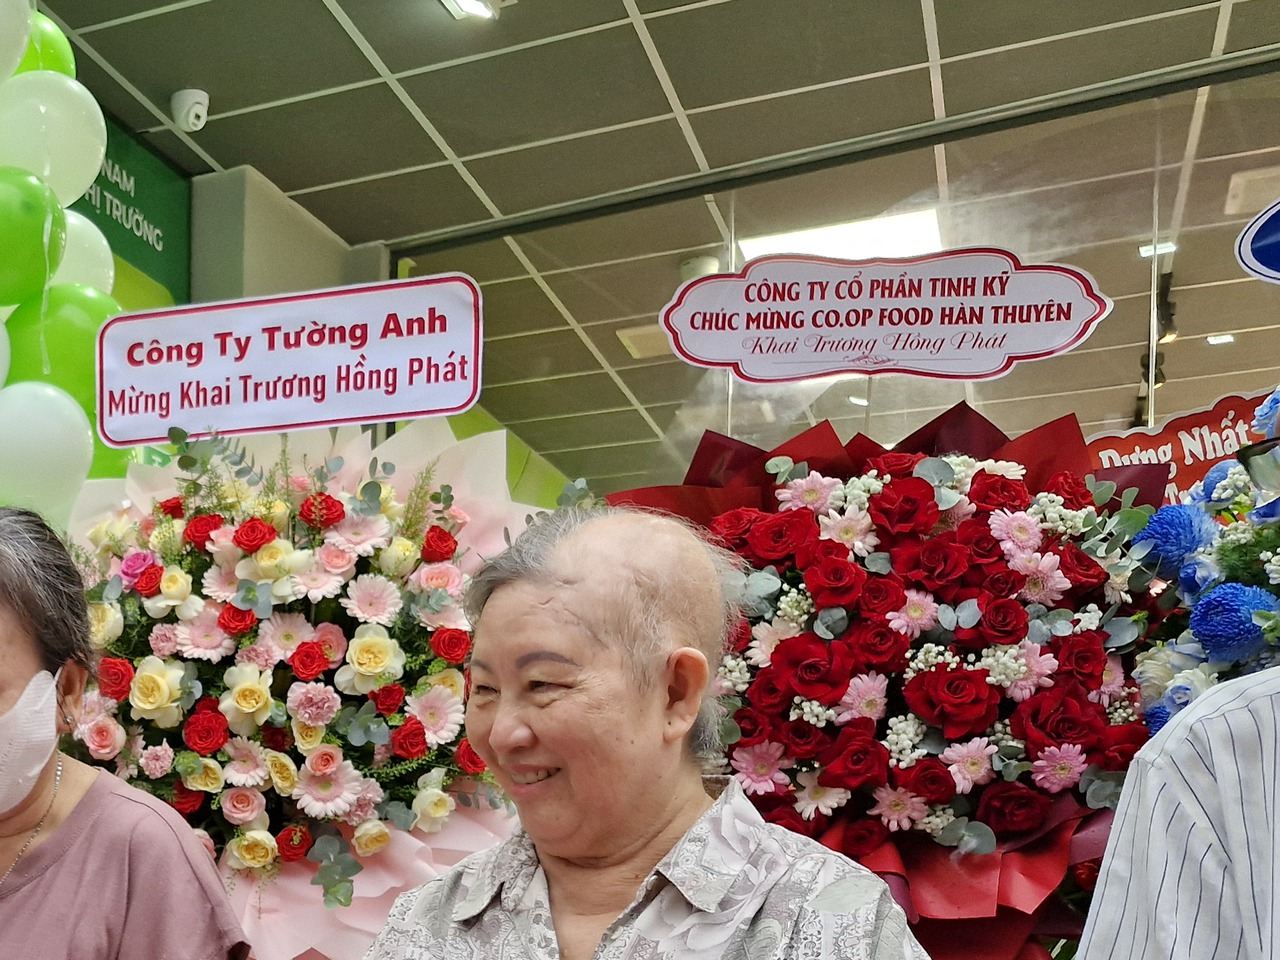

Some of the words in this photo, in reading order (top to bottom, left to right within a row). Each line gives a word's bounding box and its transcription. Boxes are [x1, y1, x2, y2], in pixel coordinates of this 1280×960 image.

[84, 183, 100, 214] HỊ
[103, 190, 163, 252] TRƯỜNG
[744, 278, 800, 303] CÔNG
[807, 281, 830, 301] TY
[834, 271, 863, 300] CỔ
[869, 272, 922, 299] PHẦN
[929, 276, 976, 298] TINH
[983, 270, 1010, 297] KỸ
[126, 339, 204, 367] Công
[214, 332, 252, 361] Ty
[262, 320, 369, 351] Tường
[380, 307, 448, 339] Anh
[689, 307, 740, 331] CHÚC
[745, 307, 805, 331] MỪNG
[811, 308, 874, 328] CO.OP
[878, 307, 934, 326] FOOD
[939, 302, 984, 325] HÀN
[991, 299, 1072, 324] THUYÊN
[741, 336, 799, 354] Khai
[803, 333, 878, 355] Trương
[882, 331, 946, 354] Hồng
[950, 330, 1009, 351] Phát
[108, 385, 170, 418] Mừng
[179, 376, 231, 409] Khai
[238, 373, 326, 403] Trương
[336, 354, 398, 395] Hồng
[408, 351, 468, 385] Phát
[1178, 410, 1252, 465] Nhất
